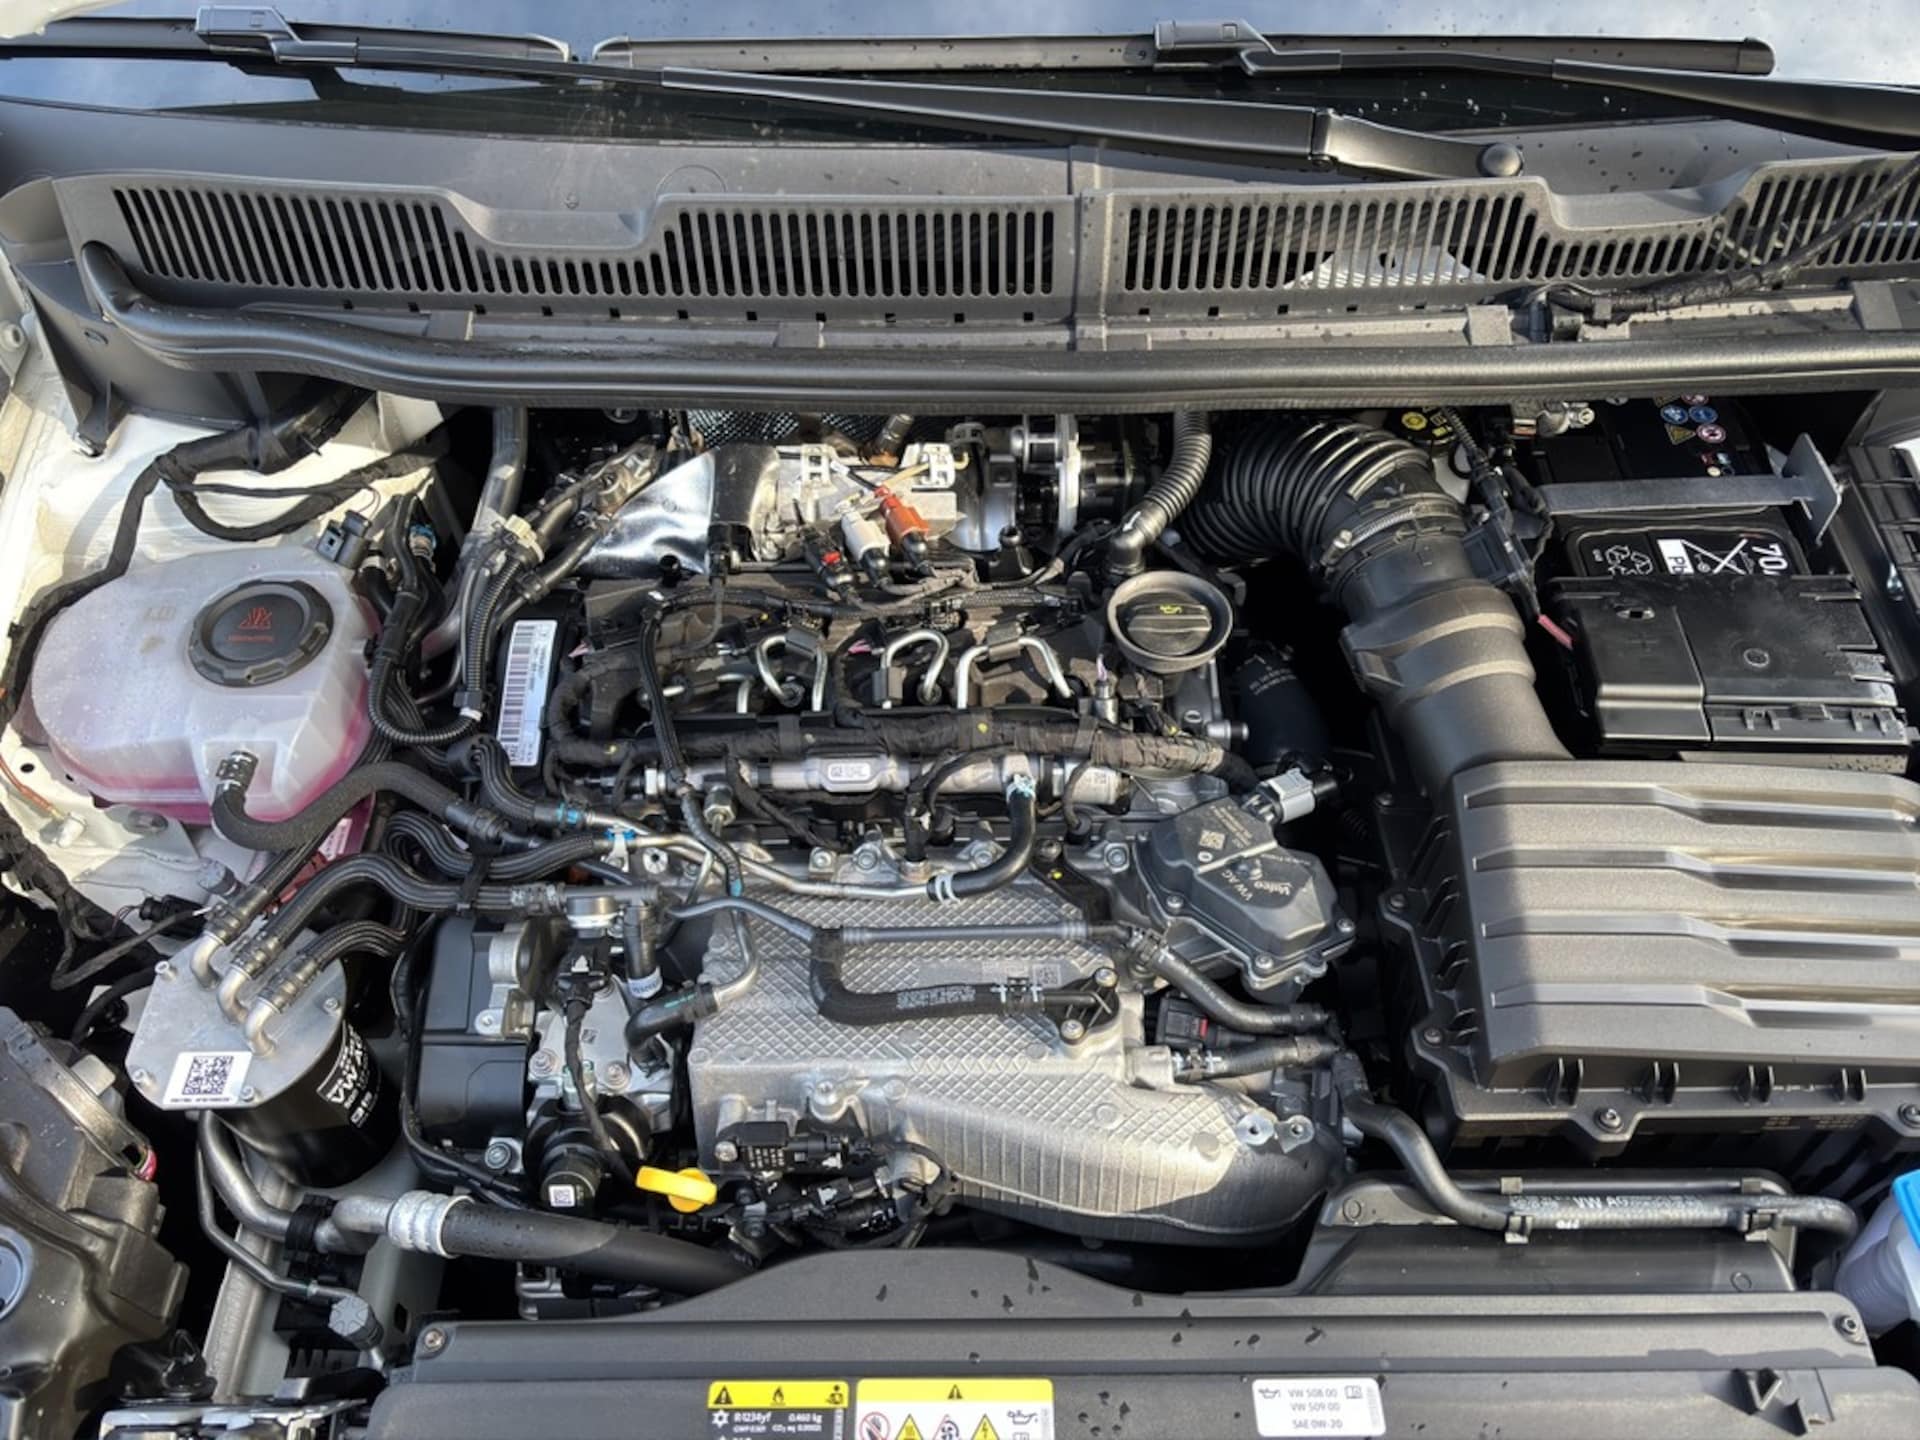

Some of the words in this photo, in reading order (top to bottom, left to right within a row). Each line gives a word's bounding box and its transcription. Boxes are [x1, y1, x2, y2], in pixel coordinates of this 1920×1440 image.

[1253, 880, 1293, 896] Valeo
[1287, 1388, 1304, 1398] VW
[1325, 1388, 1338, 1398] 00
[1290, 1402, 1307, 1412] VW
[1327, 1402, 1341, 1412] 00
[1292, 1419, 1309, 1429] SAE
